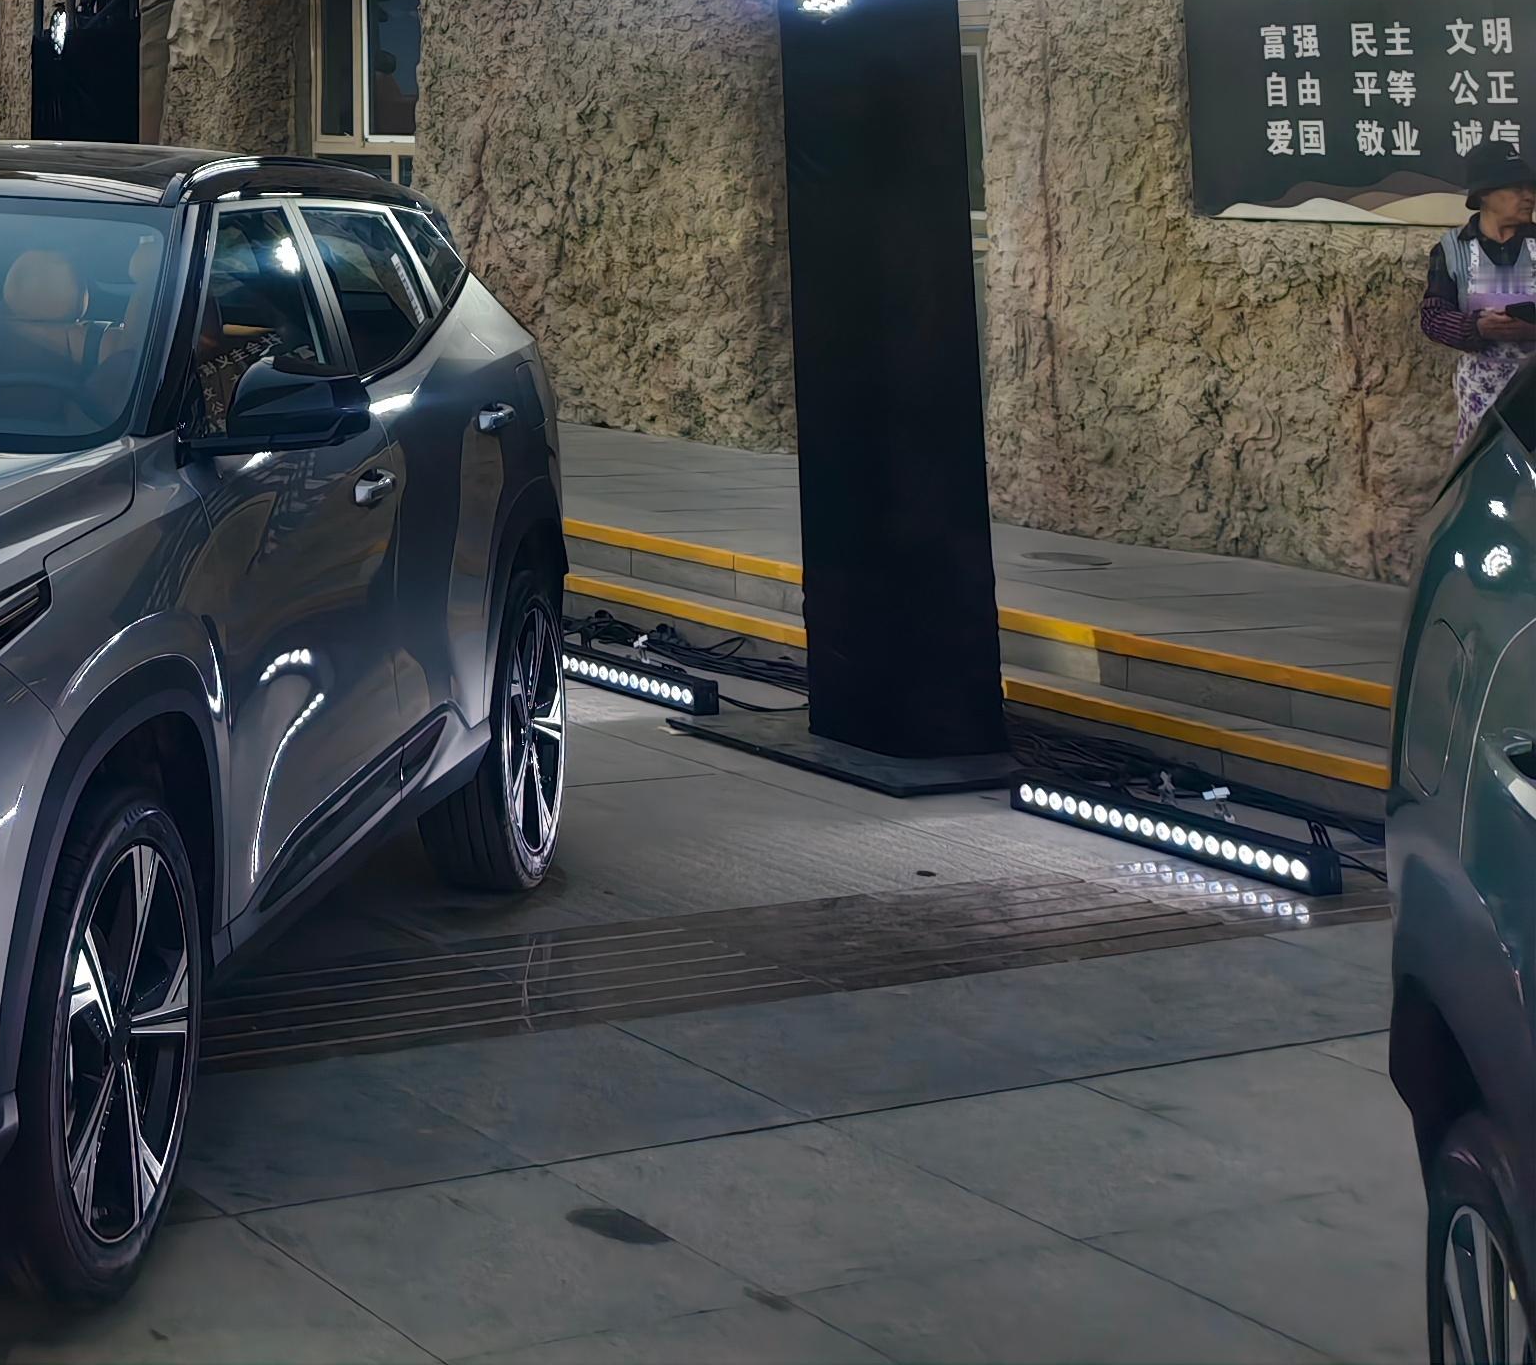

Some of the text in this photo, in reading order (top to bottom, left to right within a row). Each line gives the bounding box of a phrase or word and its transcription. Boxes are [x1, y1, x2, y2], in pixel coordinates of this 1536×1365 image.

[1260, 17, 1513, 60] 富强 民主 文明
[1265, 69, 1519, 108] 自由 平等 公正
[1266, 119, 1326, 157] 爱国
[1355, 119, 1421, 157] 敬业
